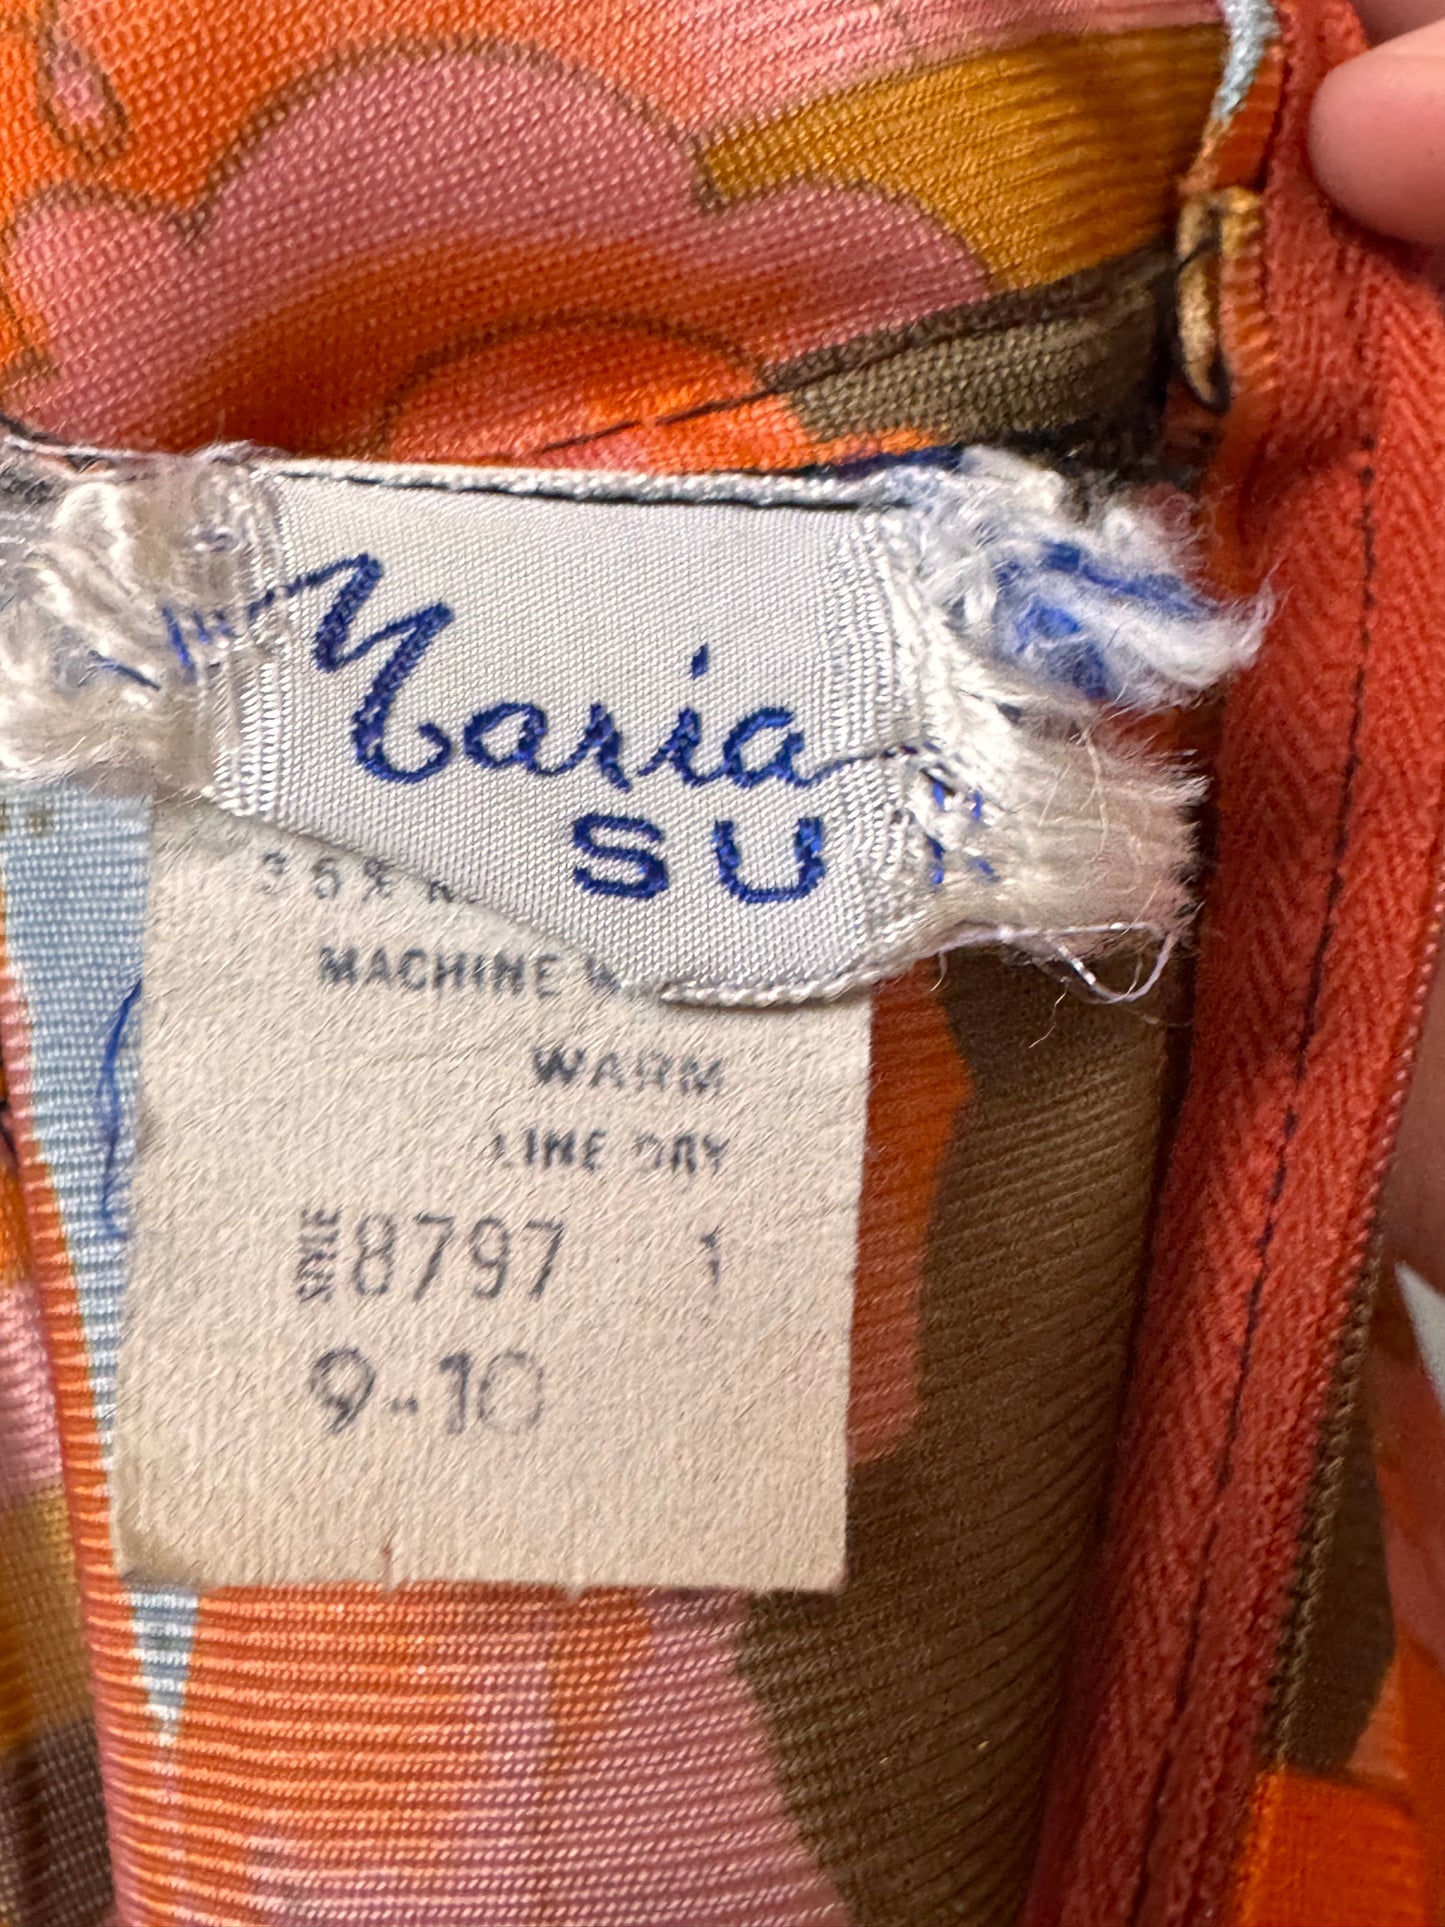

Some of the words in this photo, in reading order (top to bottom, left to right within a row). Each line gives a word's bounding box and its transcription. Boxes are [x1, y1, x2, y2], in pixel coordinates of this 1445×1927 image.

[252, 552, 850, 793] Maria
[319, 945, 561, 999] MACHINE
[532, 1047, 725, 1096] WARM
[488, 1126, 604, 1172] LINE
[352, 1212, 565, 1302] 8797
[308, 1345, 546, 1437] 9-10
